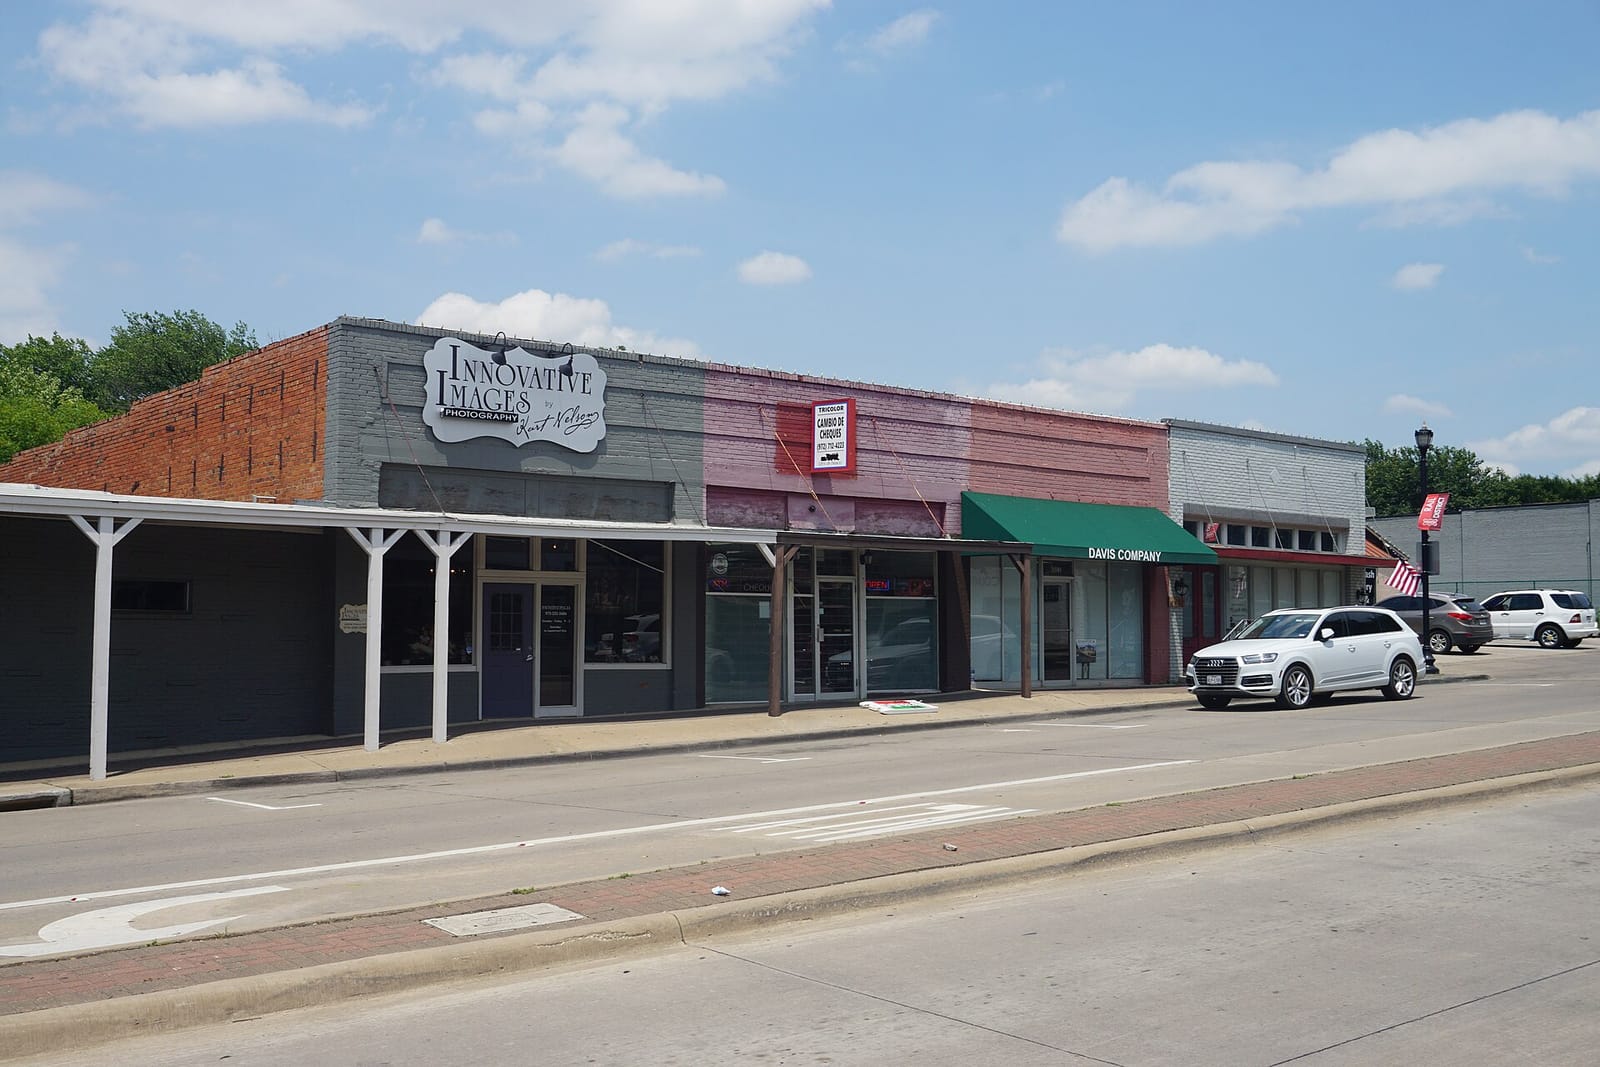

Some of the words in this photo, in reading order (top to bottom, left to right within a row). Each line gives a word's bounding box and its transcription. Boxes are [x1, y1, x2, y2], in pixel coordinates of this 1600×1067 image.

[449, 344, 592, 395] INNOVATIVE
[436, 369, 531, 414] IMAGES
[445, 408, 518, 422] PHOTOGRAPHY
[818, 405, 844, 413] TRICOLOR
[516, 416, 555, 440] Kurt
[553, 405, 599, 436] Nelson
[817, 417, 837, 428] CAMBIO
[838, 416, 845, 427] DE
[819, 428, 842, 440] CHEQUES
[1423, 497, 1436, 512] RAIL
[1432, 497, 1445, 518] DISTRICT
[1088, 547, 1116, 560] DAVIS
[1118, 549, 1162, 562] COMPANY
